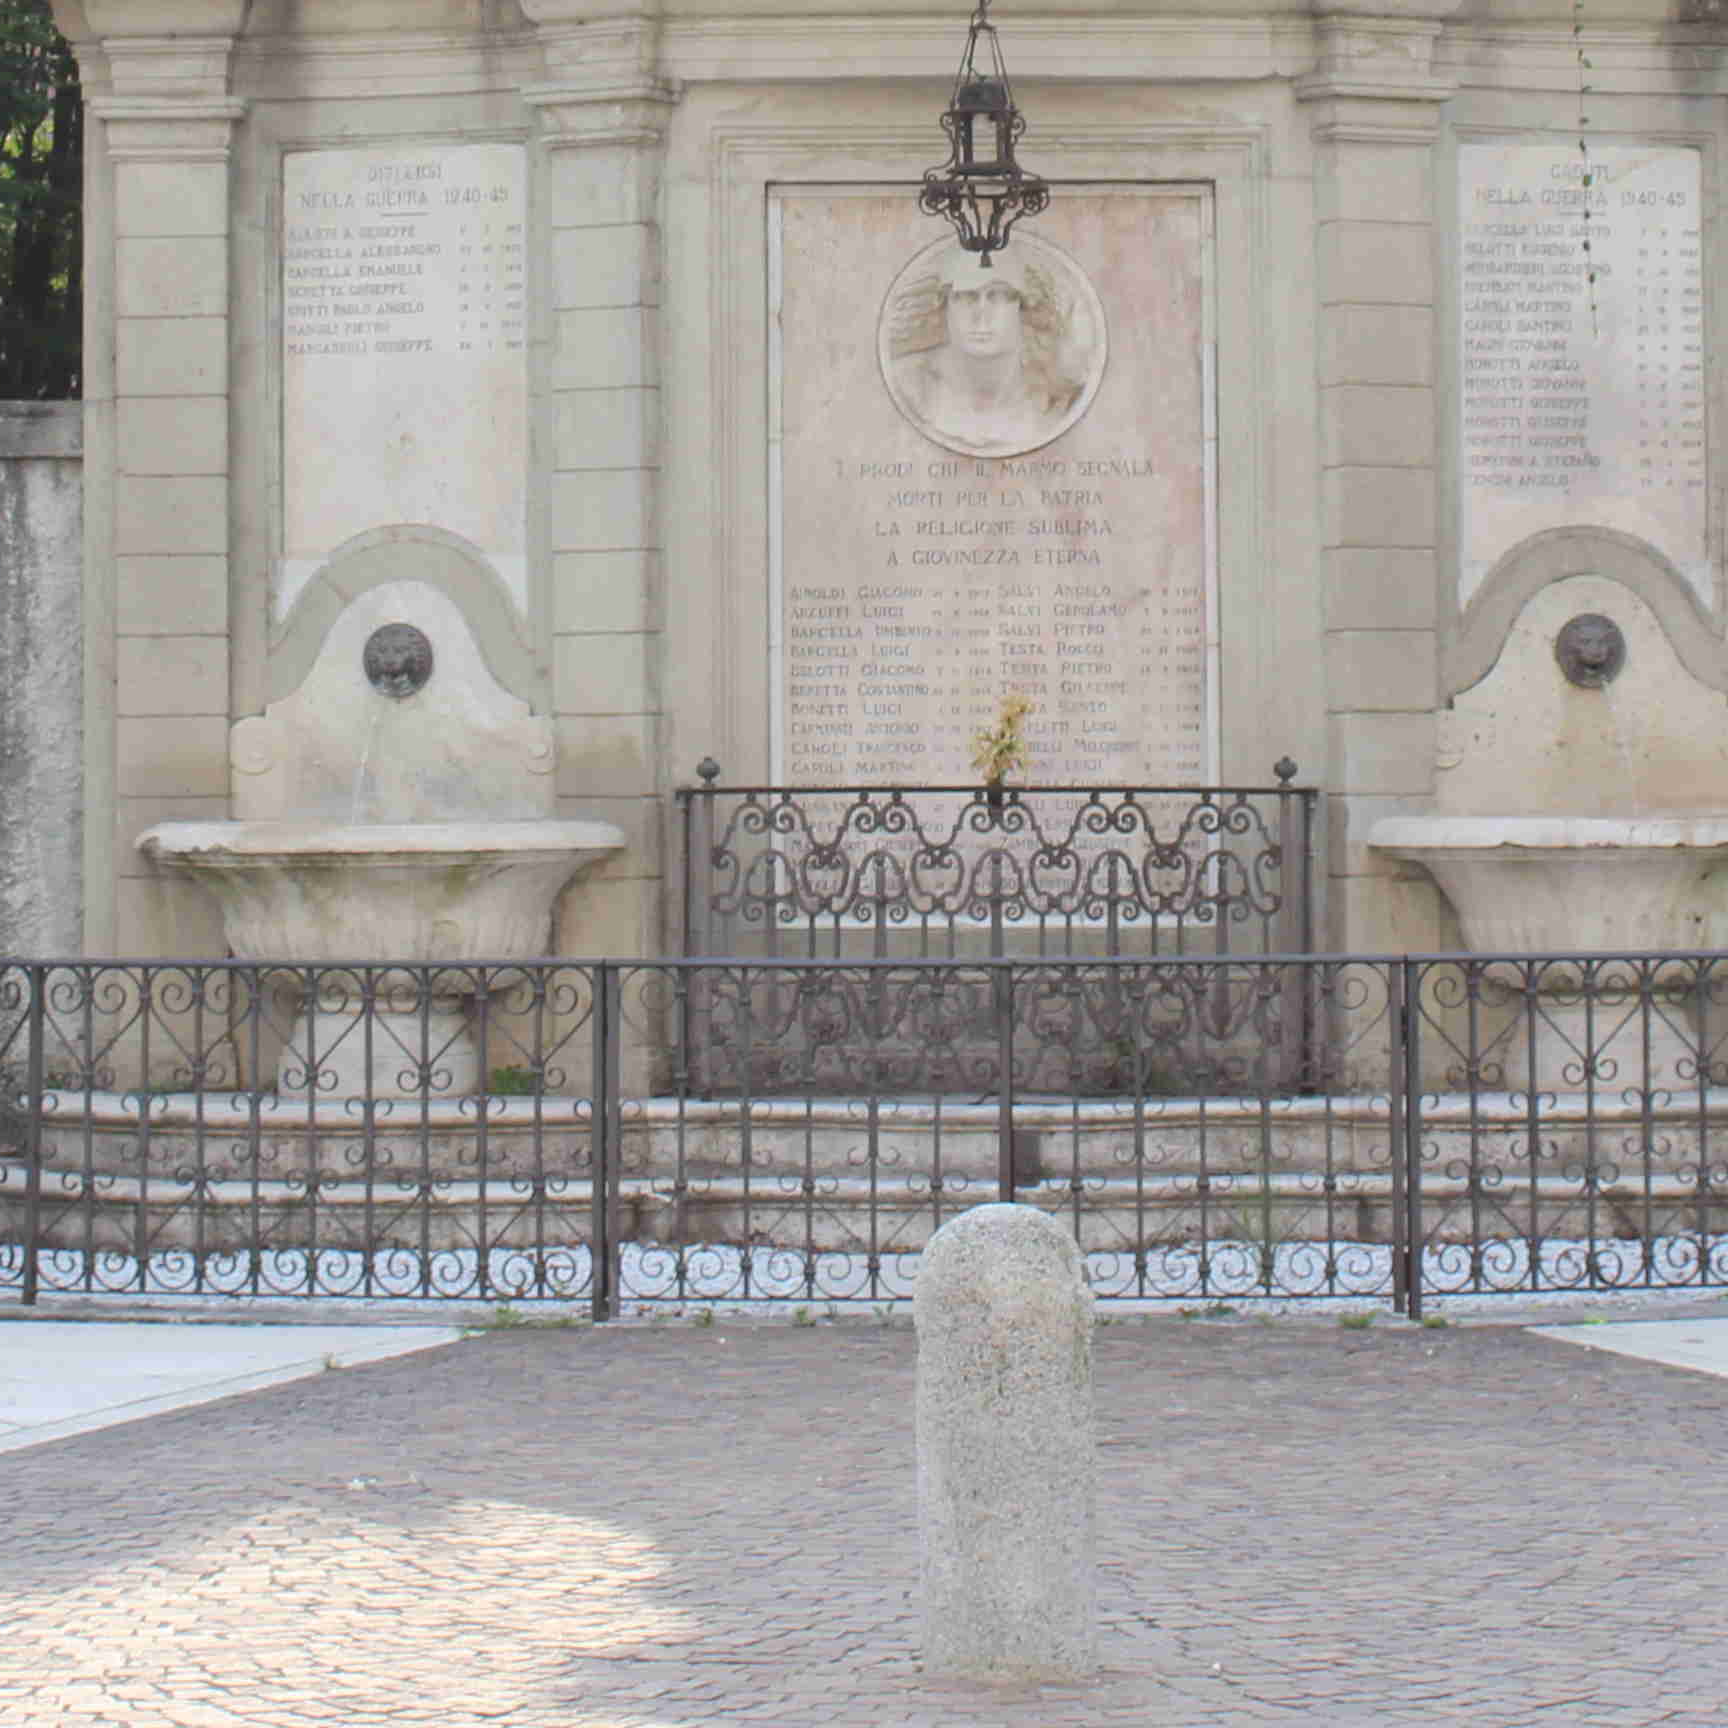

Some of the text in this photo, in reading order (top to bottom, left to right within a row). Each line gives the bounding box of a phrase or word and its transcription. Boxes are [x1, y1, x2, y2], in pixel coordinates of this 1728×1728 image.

[300, 186, 509, 208] NELLA GUERRA 1940-45
[1475, 188, 1687, 208] NELLA GUERRA 1940-45
[1001, 459, 1067, 478] MARMO
[1076, 458, 1154, 478] SEGNALA
[888, 488, 1104, 507] MORTI PER LA PATRIA
[875, 518, 1113, 538] LA RELIGIONE SUBLIMA
[887, 547, 1102, 568] A GIOVINEZZA ETERNA
[863, 604, 905, 618] LUIGI
[999, 642, 1045, 656] TESTA
[791, 663, 849, 677] BELOTTI
[860, 662, 926, 677] GIACOMO
[999, 662, 1112, 677] TESTA PIETRO
[863, 702, 903, 716] LUIGI
